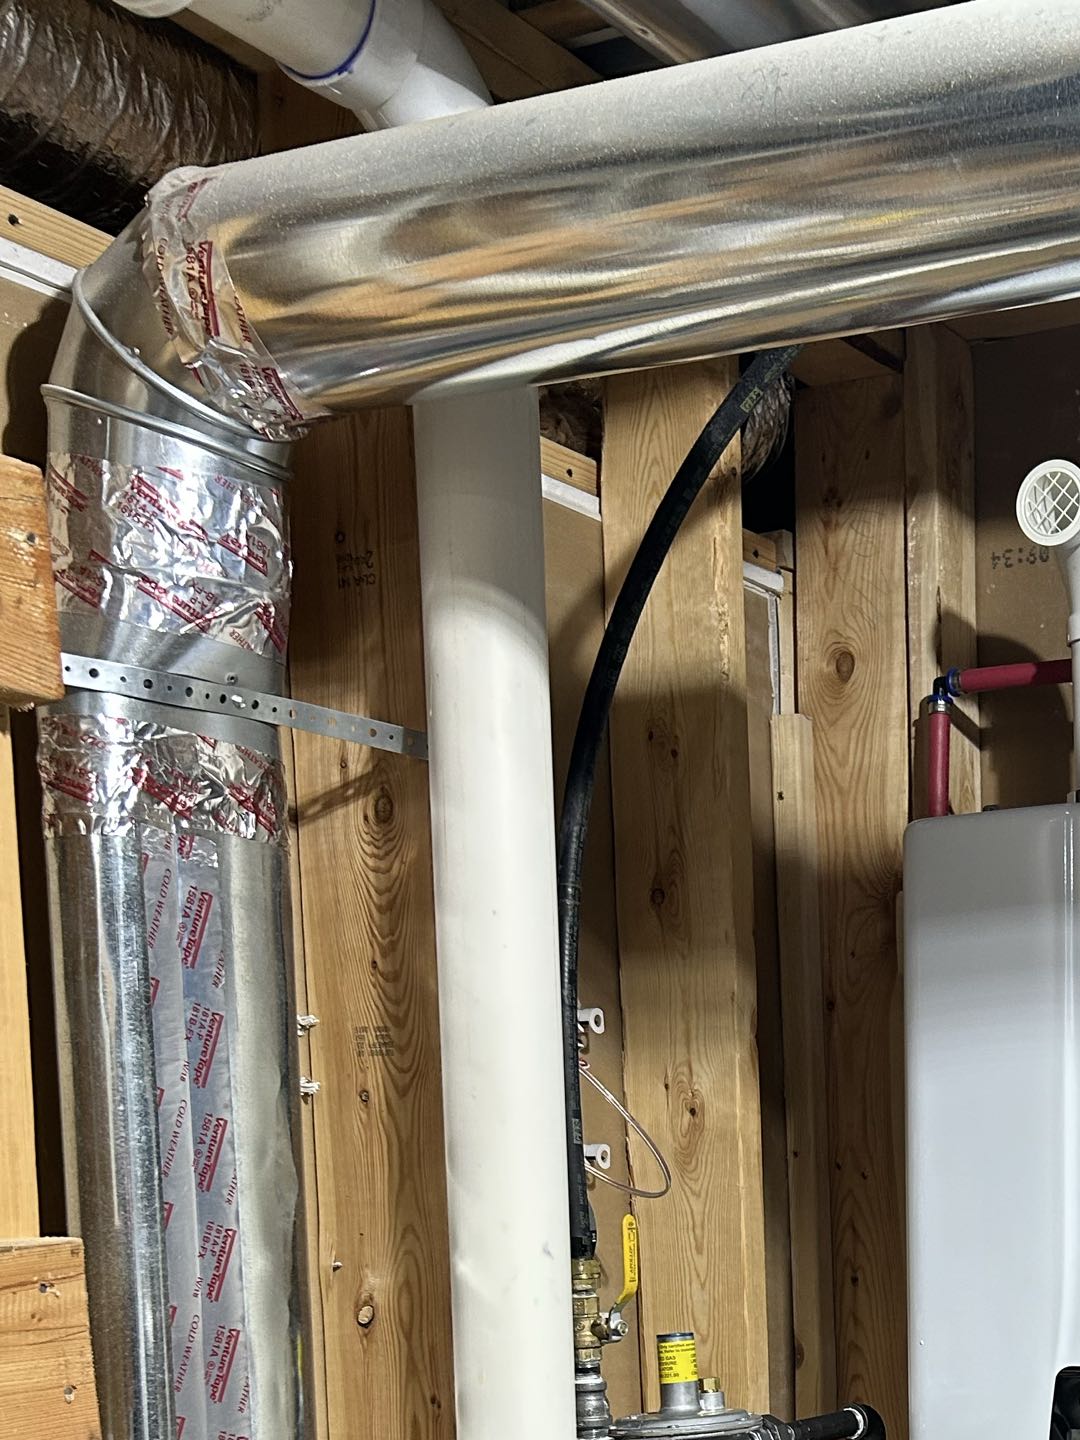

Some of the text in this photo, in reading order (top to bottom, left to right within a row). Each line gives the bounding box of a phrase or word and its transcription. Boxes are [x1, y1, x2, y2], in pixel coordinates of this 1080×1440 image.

[158, 868, 172, 898] COLD
[181, 885, 198, 919] 1581A
[182, 891, 210, 968] VentureTape
[193, 1011, 222, 1087] VentureTape
[161, 1099, 188, 1178] COLD WEATHER
[197, 1112, 214, 1145] 1581A
[198, 1117, 226, 1191] VentureTape
[207, 1228, 234, 1302] VentureTape
[174, 1314, 200, 1393] COLD WEATHER
[210, 1323, 226, 1357] 1581A
[210, 1328, 238, 1402] VentureTape
